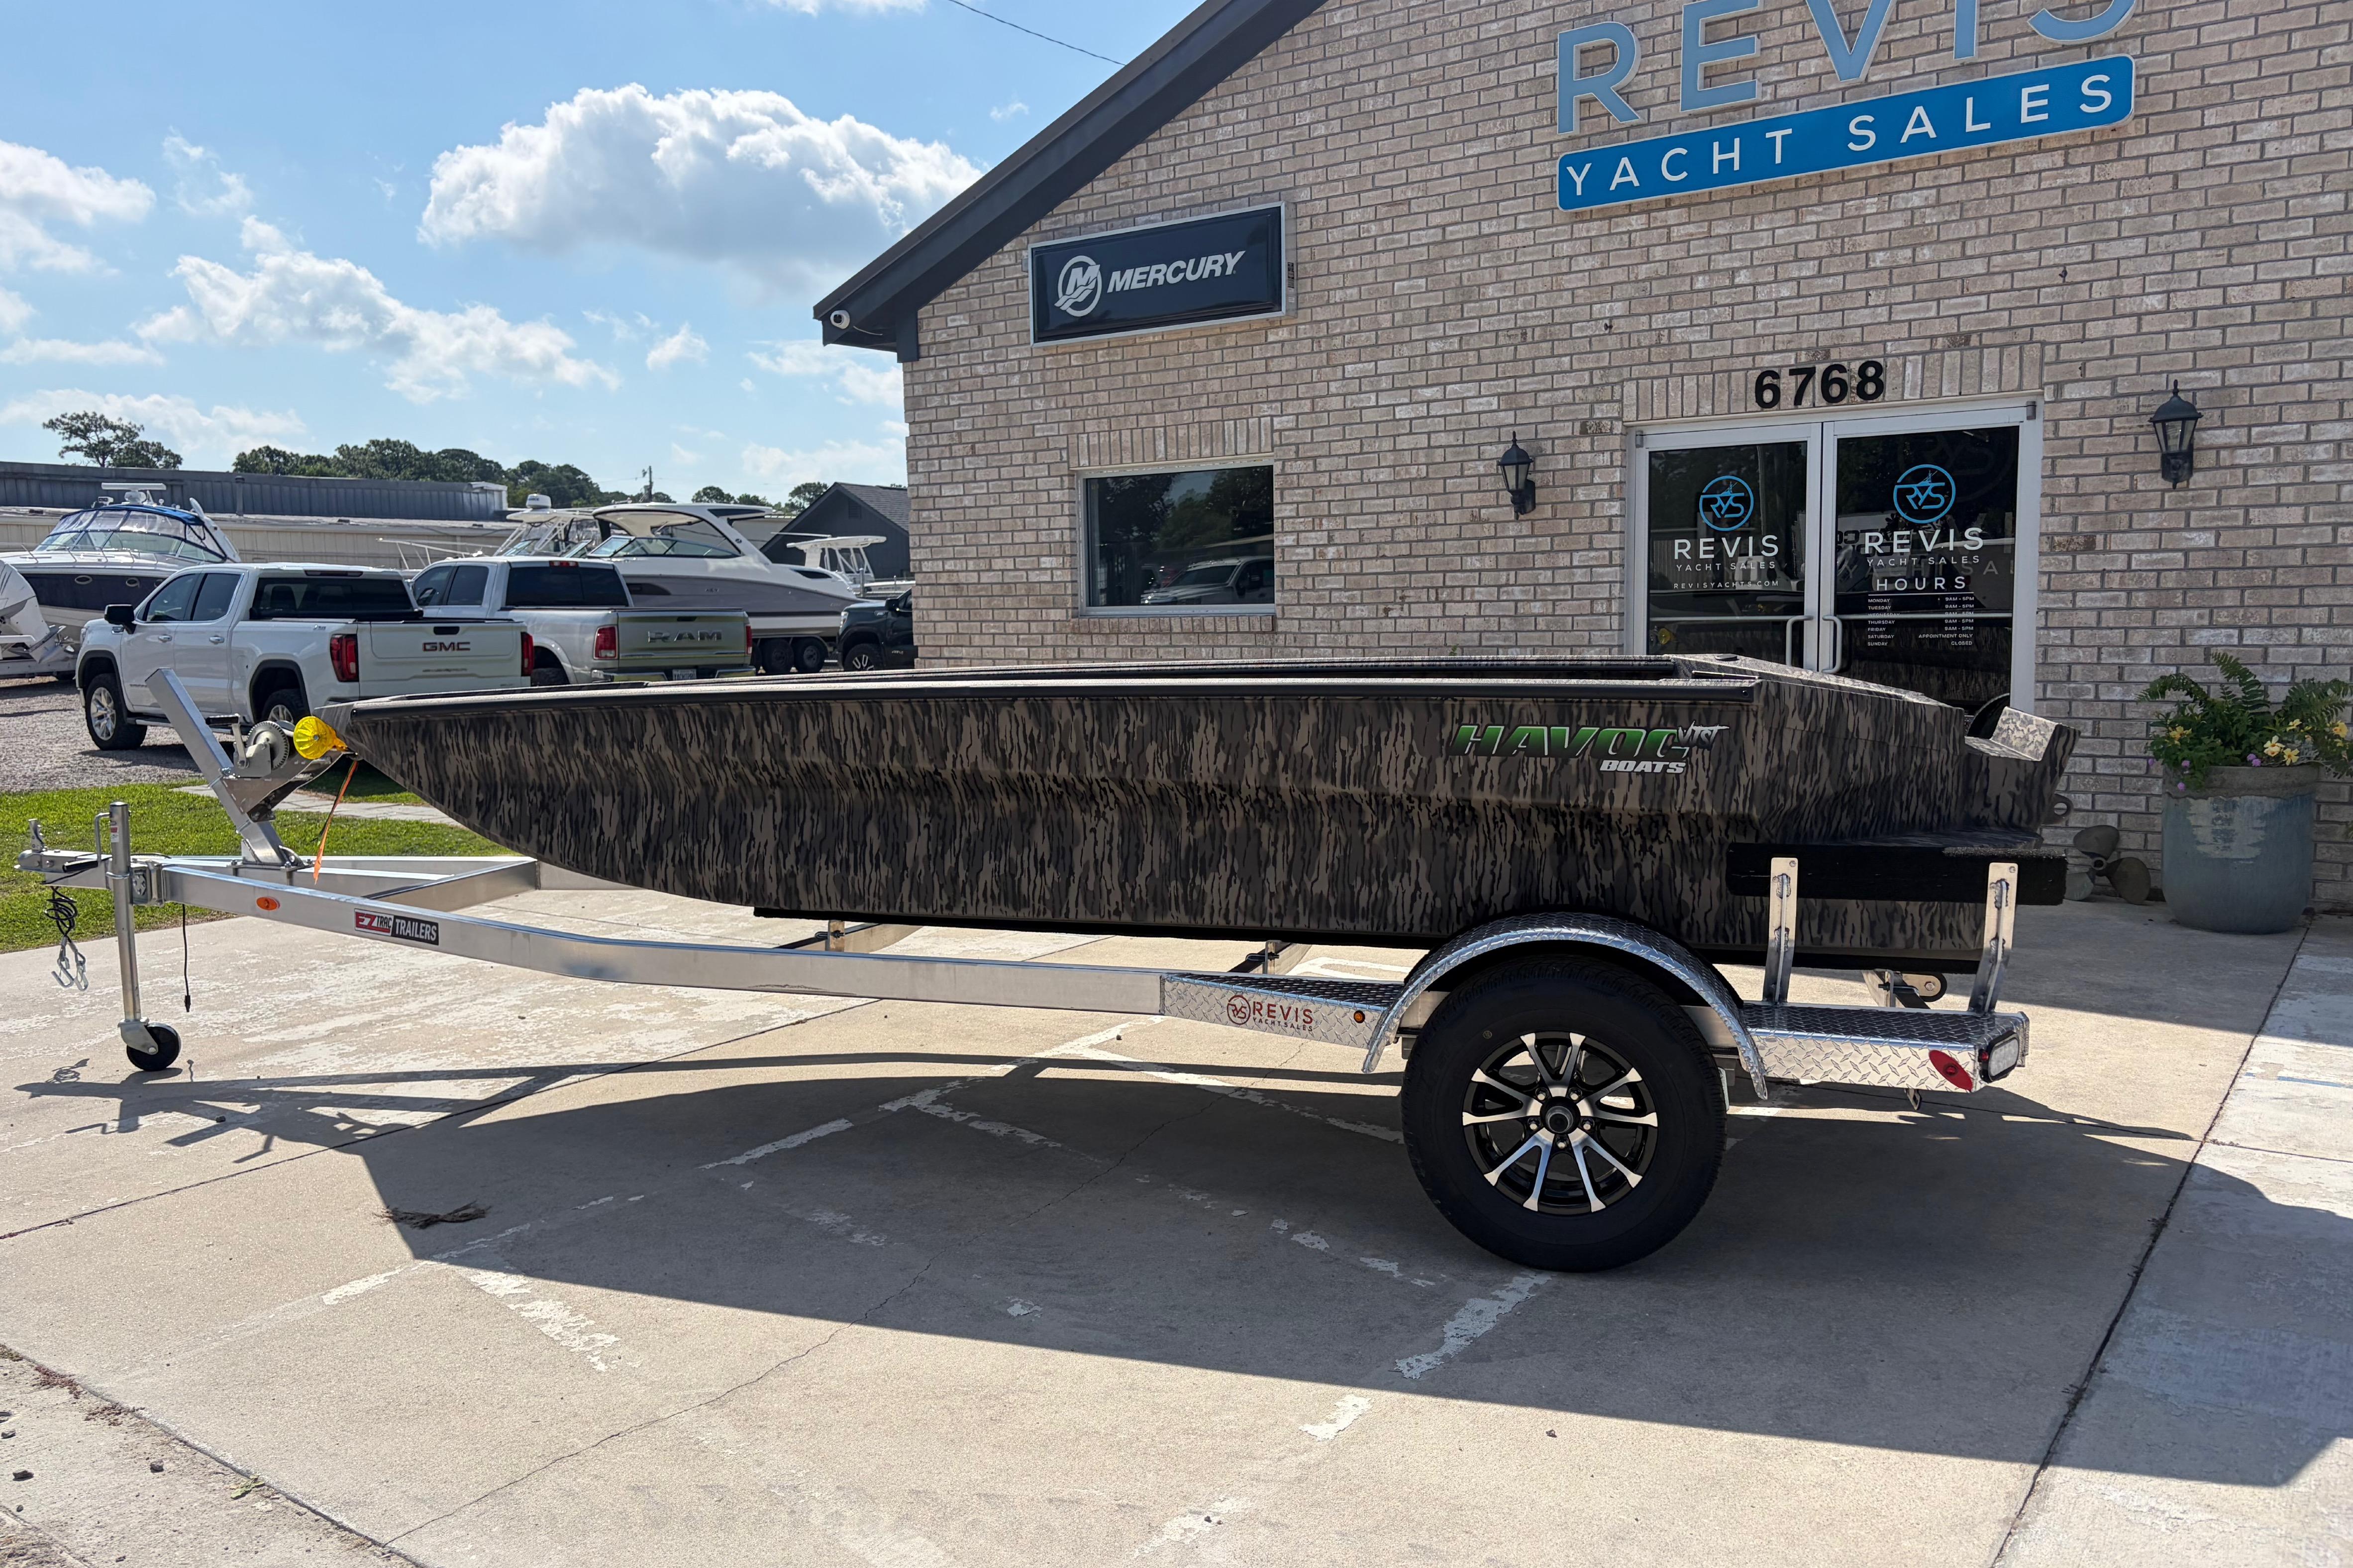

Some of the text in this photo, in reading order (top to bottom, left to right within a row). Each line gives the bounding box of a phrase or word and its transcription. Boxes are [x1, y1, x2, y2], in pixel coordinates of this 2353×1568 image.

[1566, 74, 2112, 196] YACHT SALES
[1107, 250, 1246, 293] MERCURY
[1754, 360, 1884, 409] 6768
[1674, 534, 1779, 560] REVIS
[1864, 527, 1984, 554] REVIS
[1676, 561, 1776, 572] YACHT SALES
[1867, 555, 1980, 567] YACHT SALES
[1674, 581, 1779, 589] REVISYACHTSCOM
[1876, 576, 1966, 591] HOURS
[648, 630, 722, 643] RAM
[422, 641, 471, 652] GMC
[1450, 724, 1691, 759] HAVOC
[1600, 760, 1686, 774] BOATS
[395, 918, 437, 941] TRAILERS
[1253, 1001, 1314, 1024] REVIS
[1253, 1017, 1313, 1032] YACHT SALES
